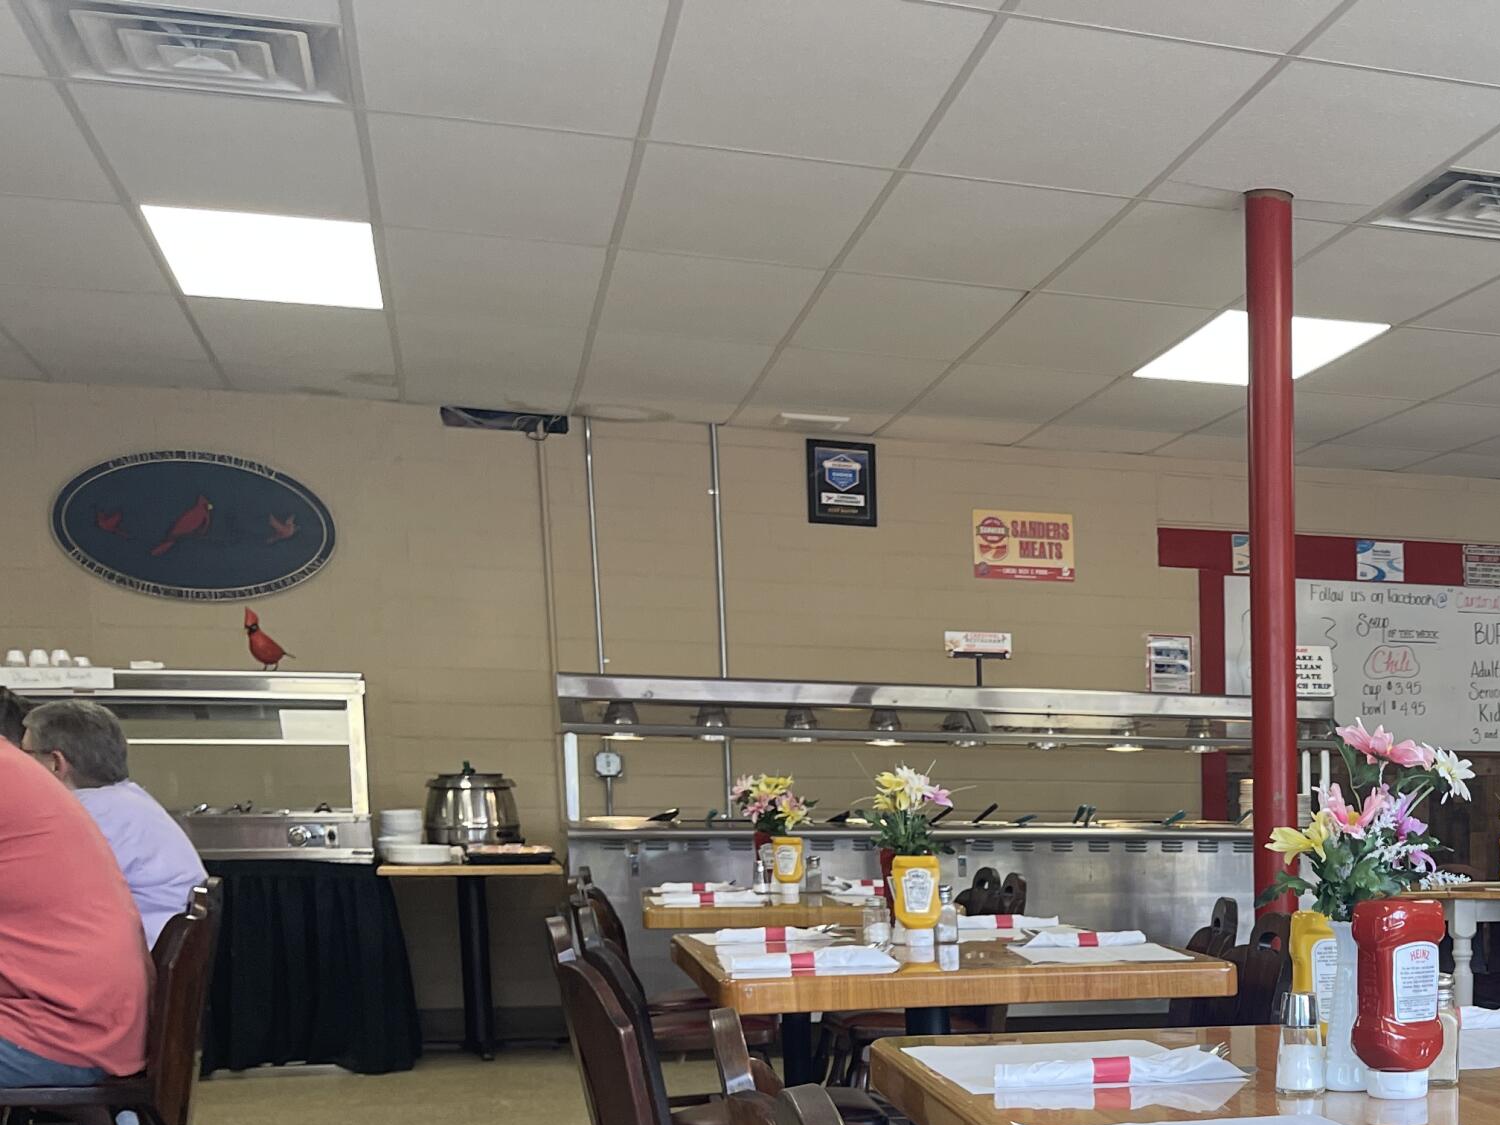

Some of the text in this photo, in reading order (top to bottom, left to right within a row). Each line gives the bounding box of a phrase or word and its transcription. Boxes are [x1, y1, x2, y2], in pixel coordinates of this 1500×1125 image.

[1010, 520, 1069, 541] SANDERS
[1019, 541, 1063, 560] MEATS
[1310, 584, 1344, 602] Follow
[1350, 590, 1366, 601] us
[1370, 592, 1384, 604] on
[1356, 612, 1390, 643] Soup
[1371, 649, 1414, 674] Chili
[1362, 683, 1382, 700] cup
[1362, 699, 1387, 716] bowl
[1470, 727, 1482, 745] 3
[1484, 728, 1498, 738] and
[1409, 948, 1430, 961] HEINZ
